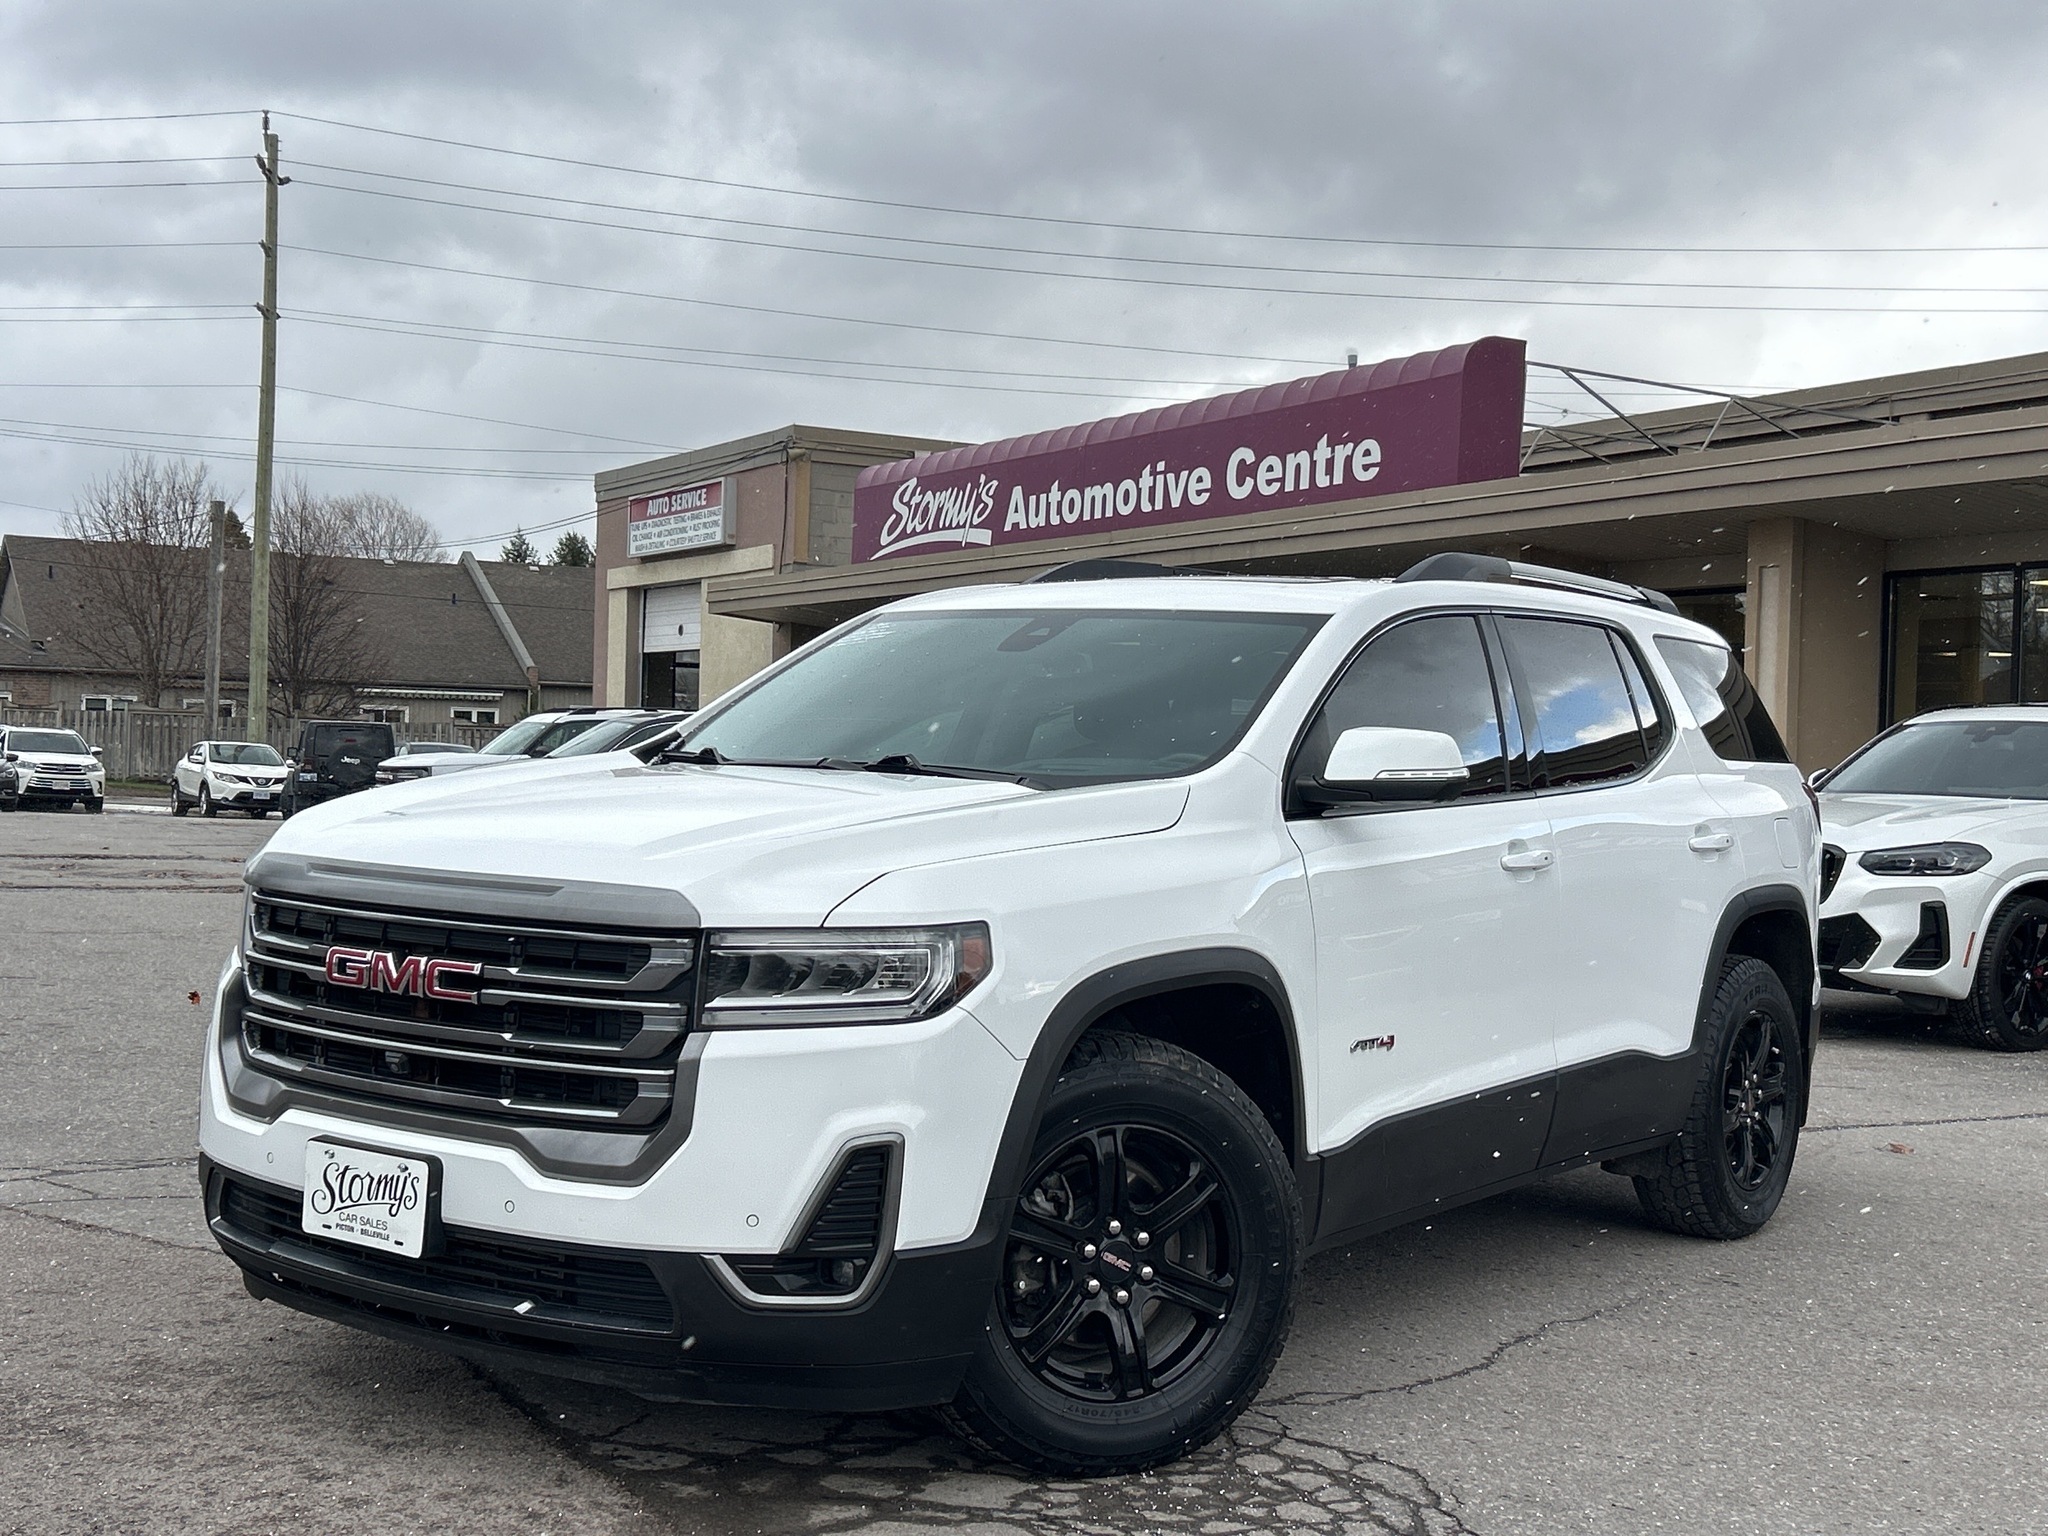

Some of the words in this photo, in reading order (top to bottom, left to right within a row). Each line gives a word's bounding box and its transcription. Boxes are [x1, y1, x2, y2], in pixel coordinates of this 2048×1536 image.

[647, 500, 669, 516] AUTO
[671, 488, 707, 512] SERVICE
[880, 473, 999, 547] Stormy's
[1003, 460, 1212, 532] Automotive
[1226, 433, 1382, 500] Centre
[340, 756, 360, 765] Jeep
[326, 946, 483, 1005] GMC
[311, 1162, 420, 1217] Stormy's
[335, 1223, 355, 1233] PICTON
[360, 1228, 390, 1241] BELLEVILLE
[339, 1212, 357, 1224] CAR
[359, 1215, 388, 1231] SALES
